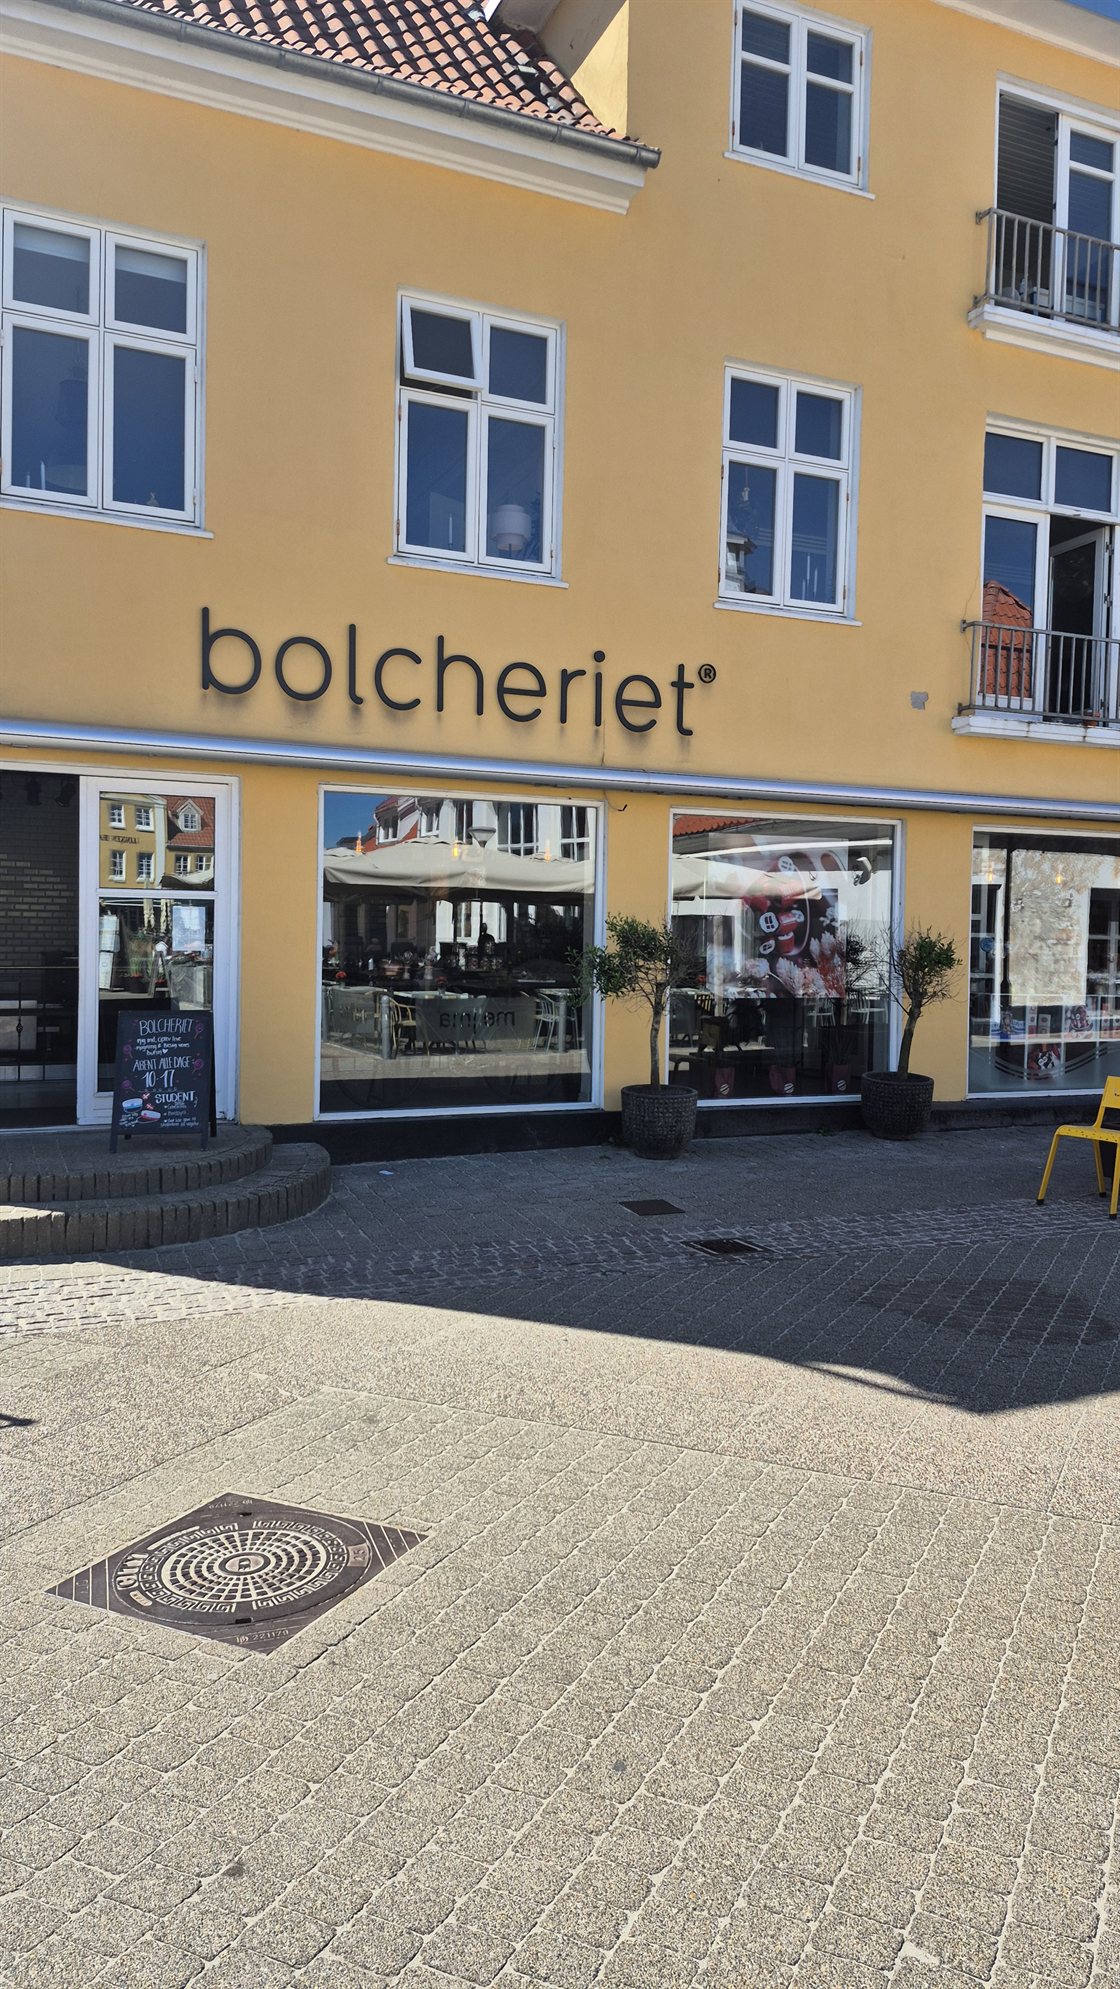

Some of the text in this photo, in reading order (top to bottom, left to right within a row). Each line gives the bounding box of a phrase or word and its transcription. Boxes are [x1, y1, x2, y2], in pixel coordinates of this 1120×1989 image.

[139, 1018, 193, 1036] BOLCHERIET
[133, 1058, 157, 1072] ÅBENT
[158, 1057, 174, 1070] ALLE
[142, 1069, 175, 1088] 10-17
[155, 1091, 196, 1104] STUDENT
[116, 1552, 149, 1591] CITY
